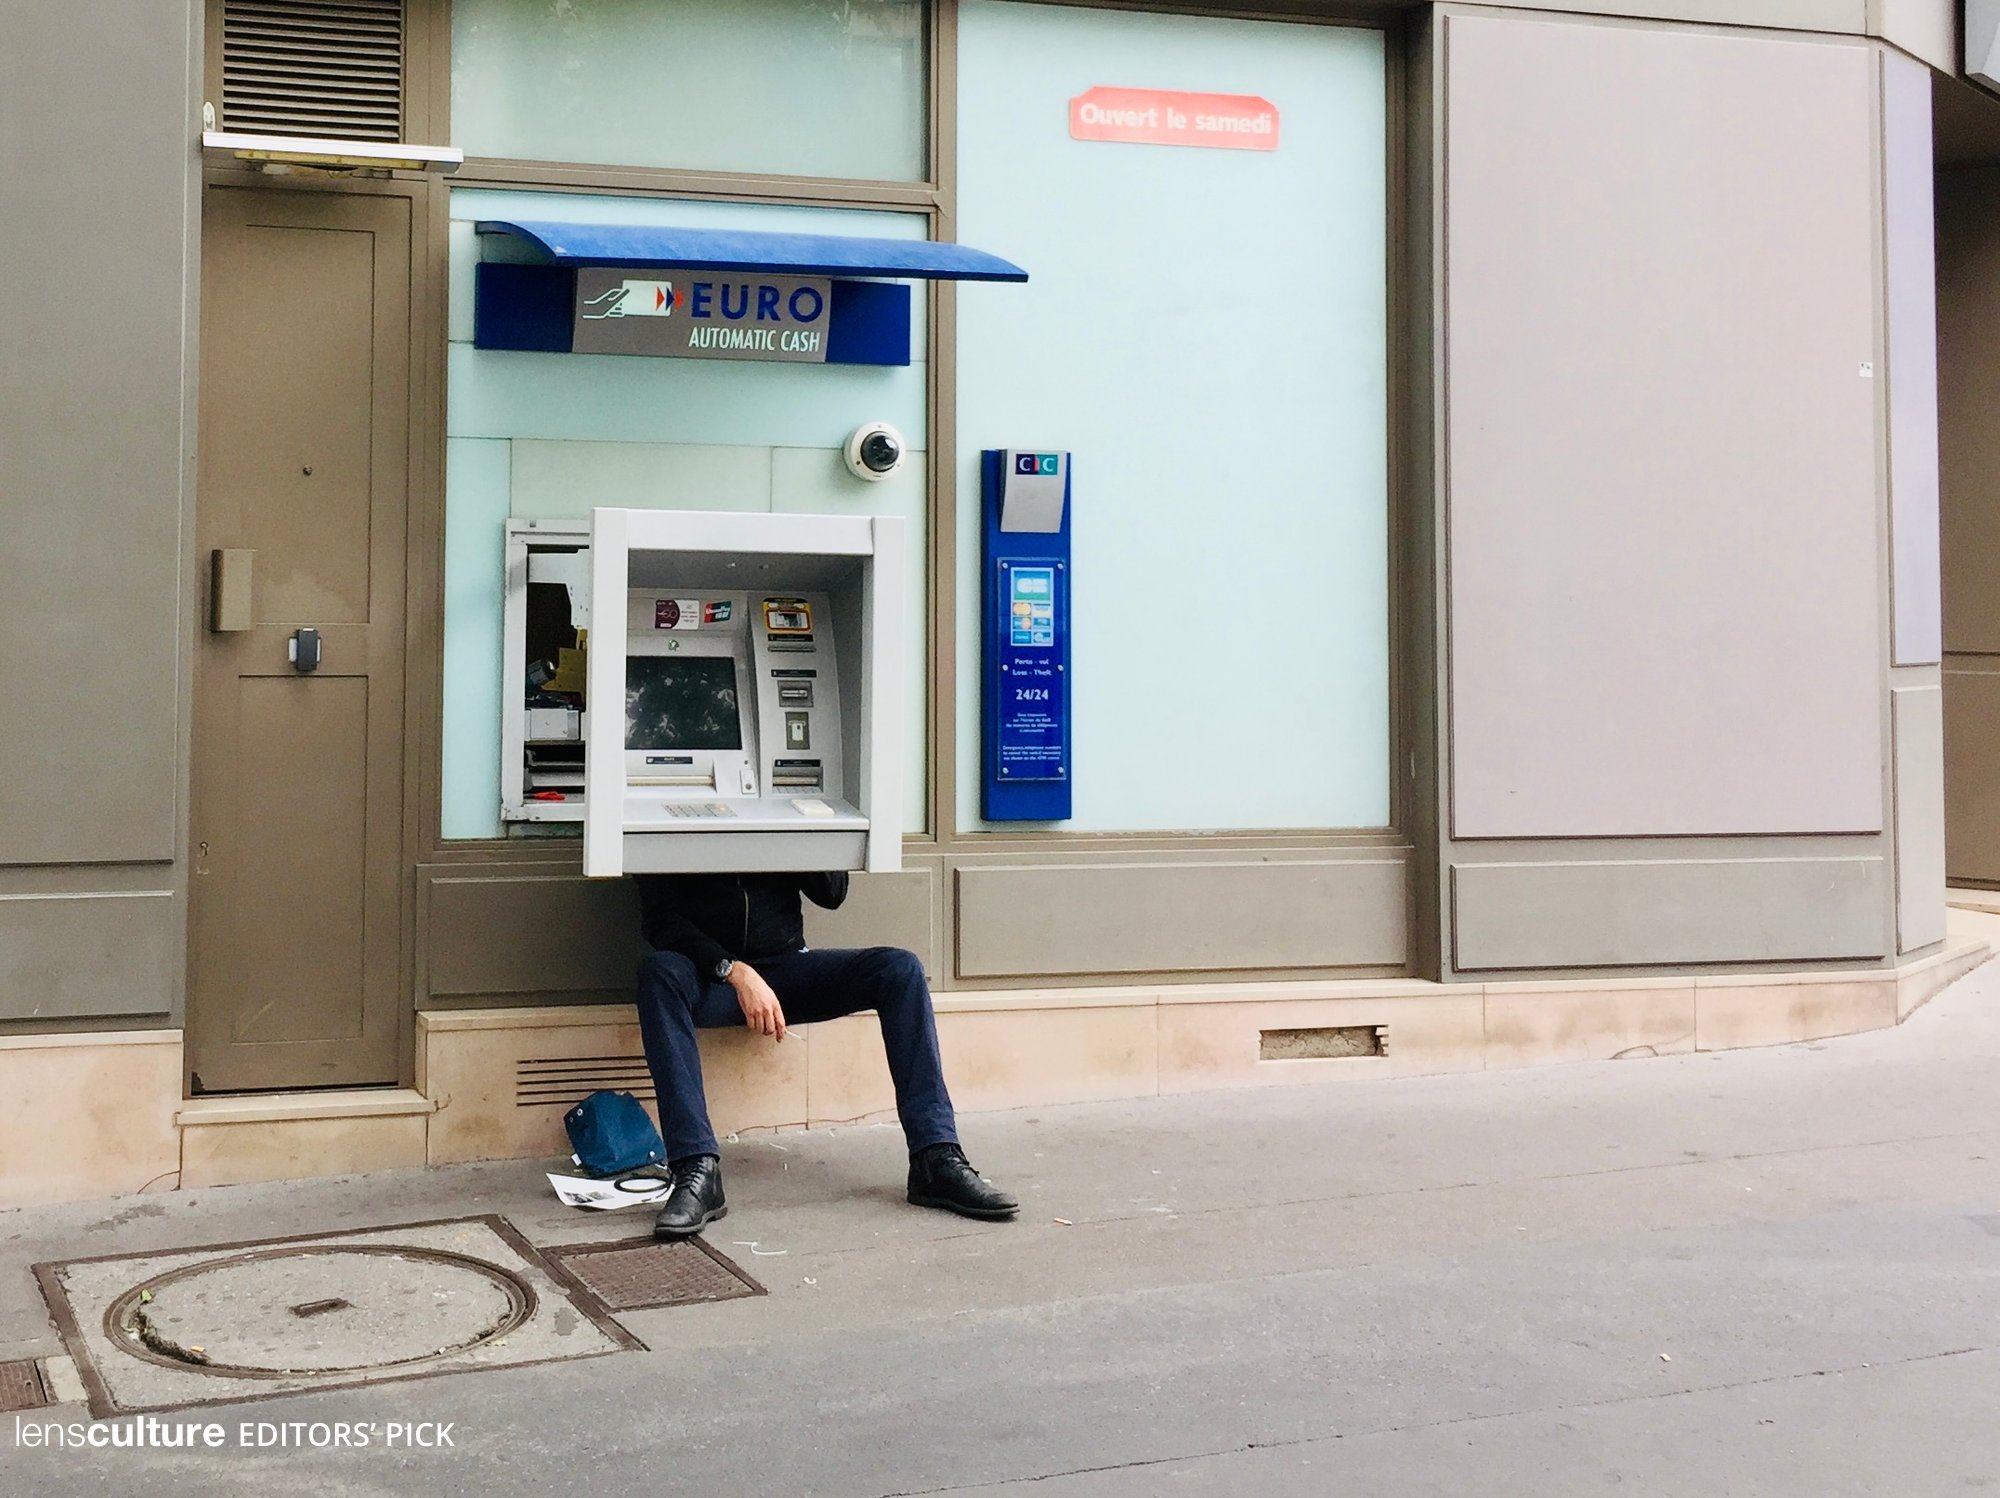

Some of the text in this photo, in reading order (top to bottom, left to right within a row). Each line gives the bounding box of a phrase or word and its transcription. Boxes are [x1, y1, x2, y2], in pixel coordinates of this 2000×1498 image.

[1079, 103, 1271, 134] Ouvert le samedi
[691, 282, 823, 323] EURO
[688, 327, 820, 352] AUTOMATIC CASH
[1019, 457, 1055, 472] CIC
[1015, 688, 1049, 701] 24/24
